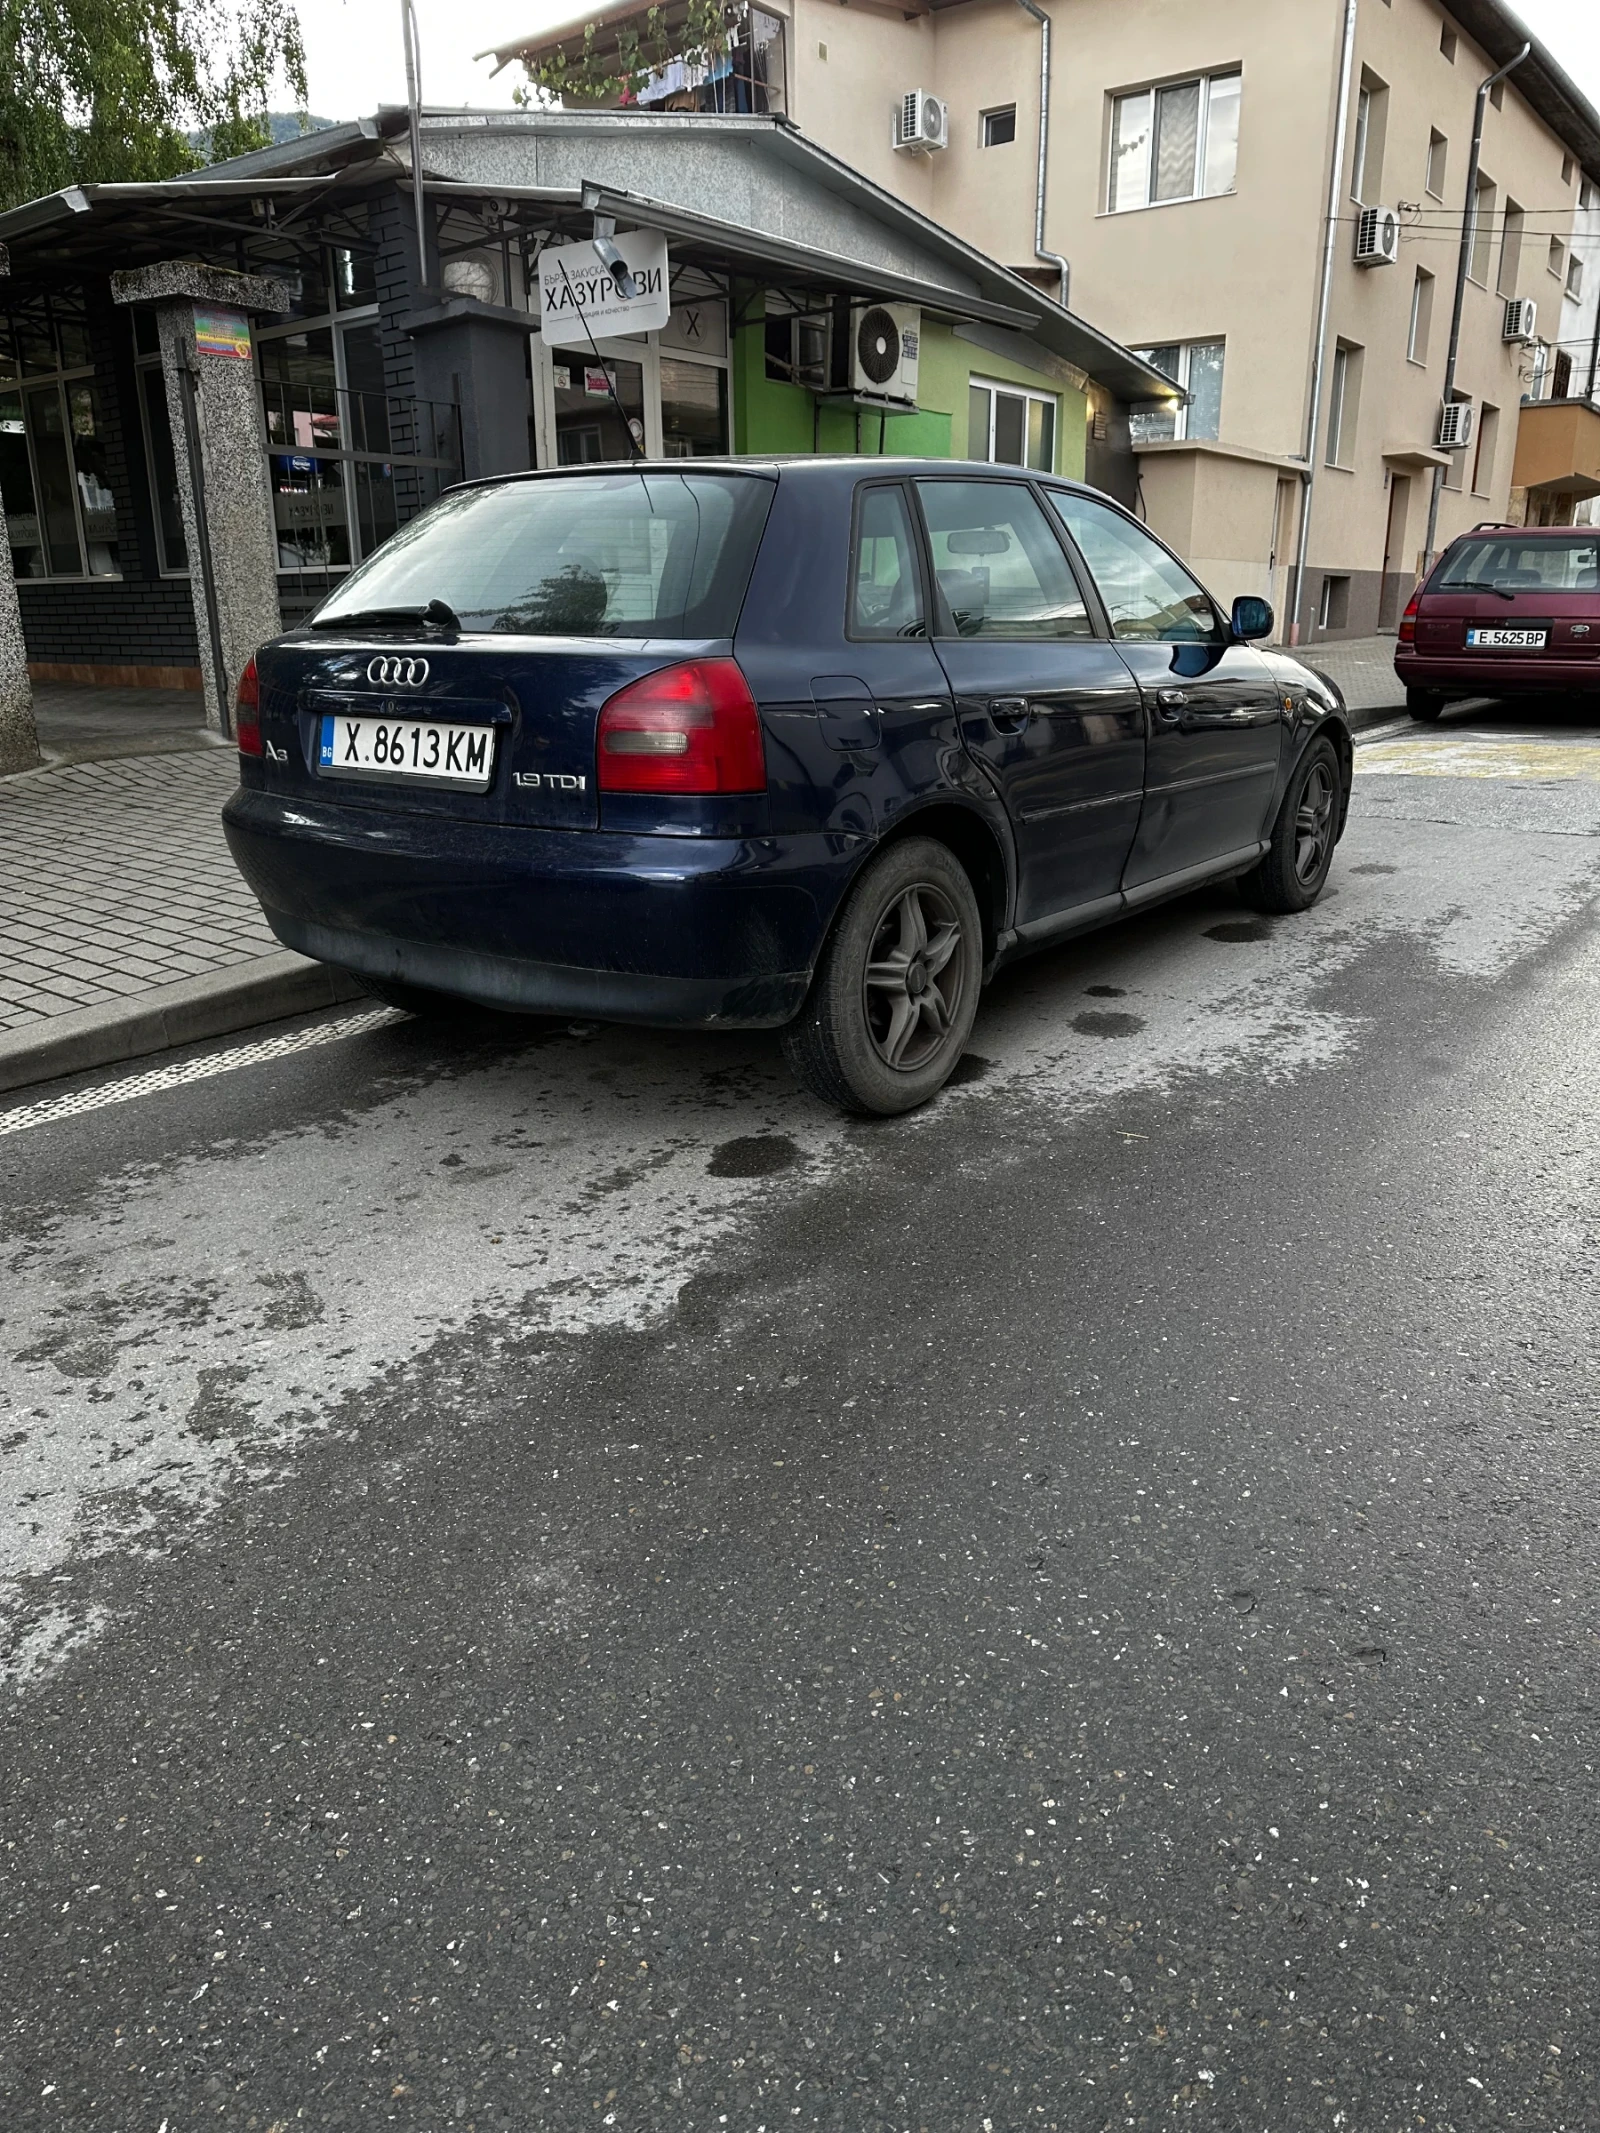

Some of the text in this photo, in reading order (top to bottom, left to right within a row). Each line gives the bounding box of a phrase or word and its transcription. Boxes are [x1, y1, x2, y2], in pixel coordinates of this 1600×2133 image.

[570, 264, 606, 280] ЗАКУСКА
[265, 740, 288, 761] A3
[322, 746, 332, 758] BG
[543, 774, 586, 790] TDI
